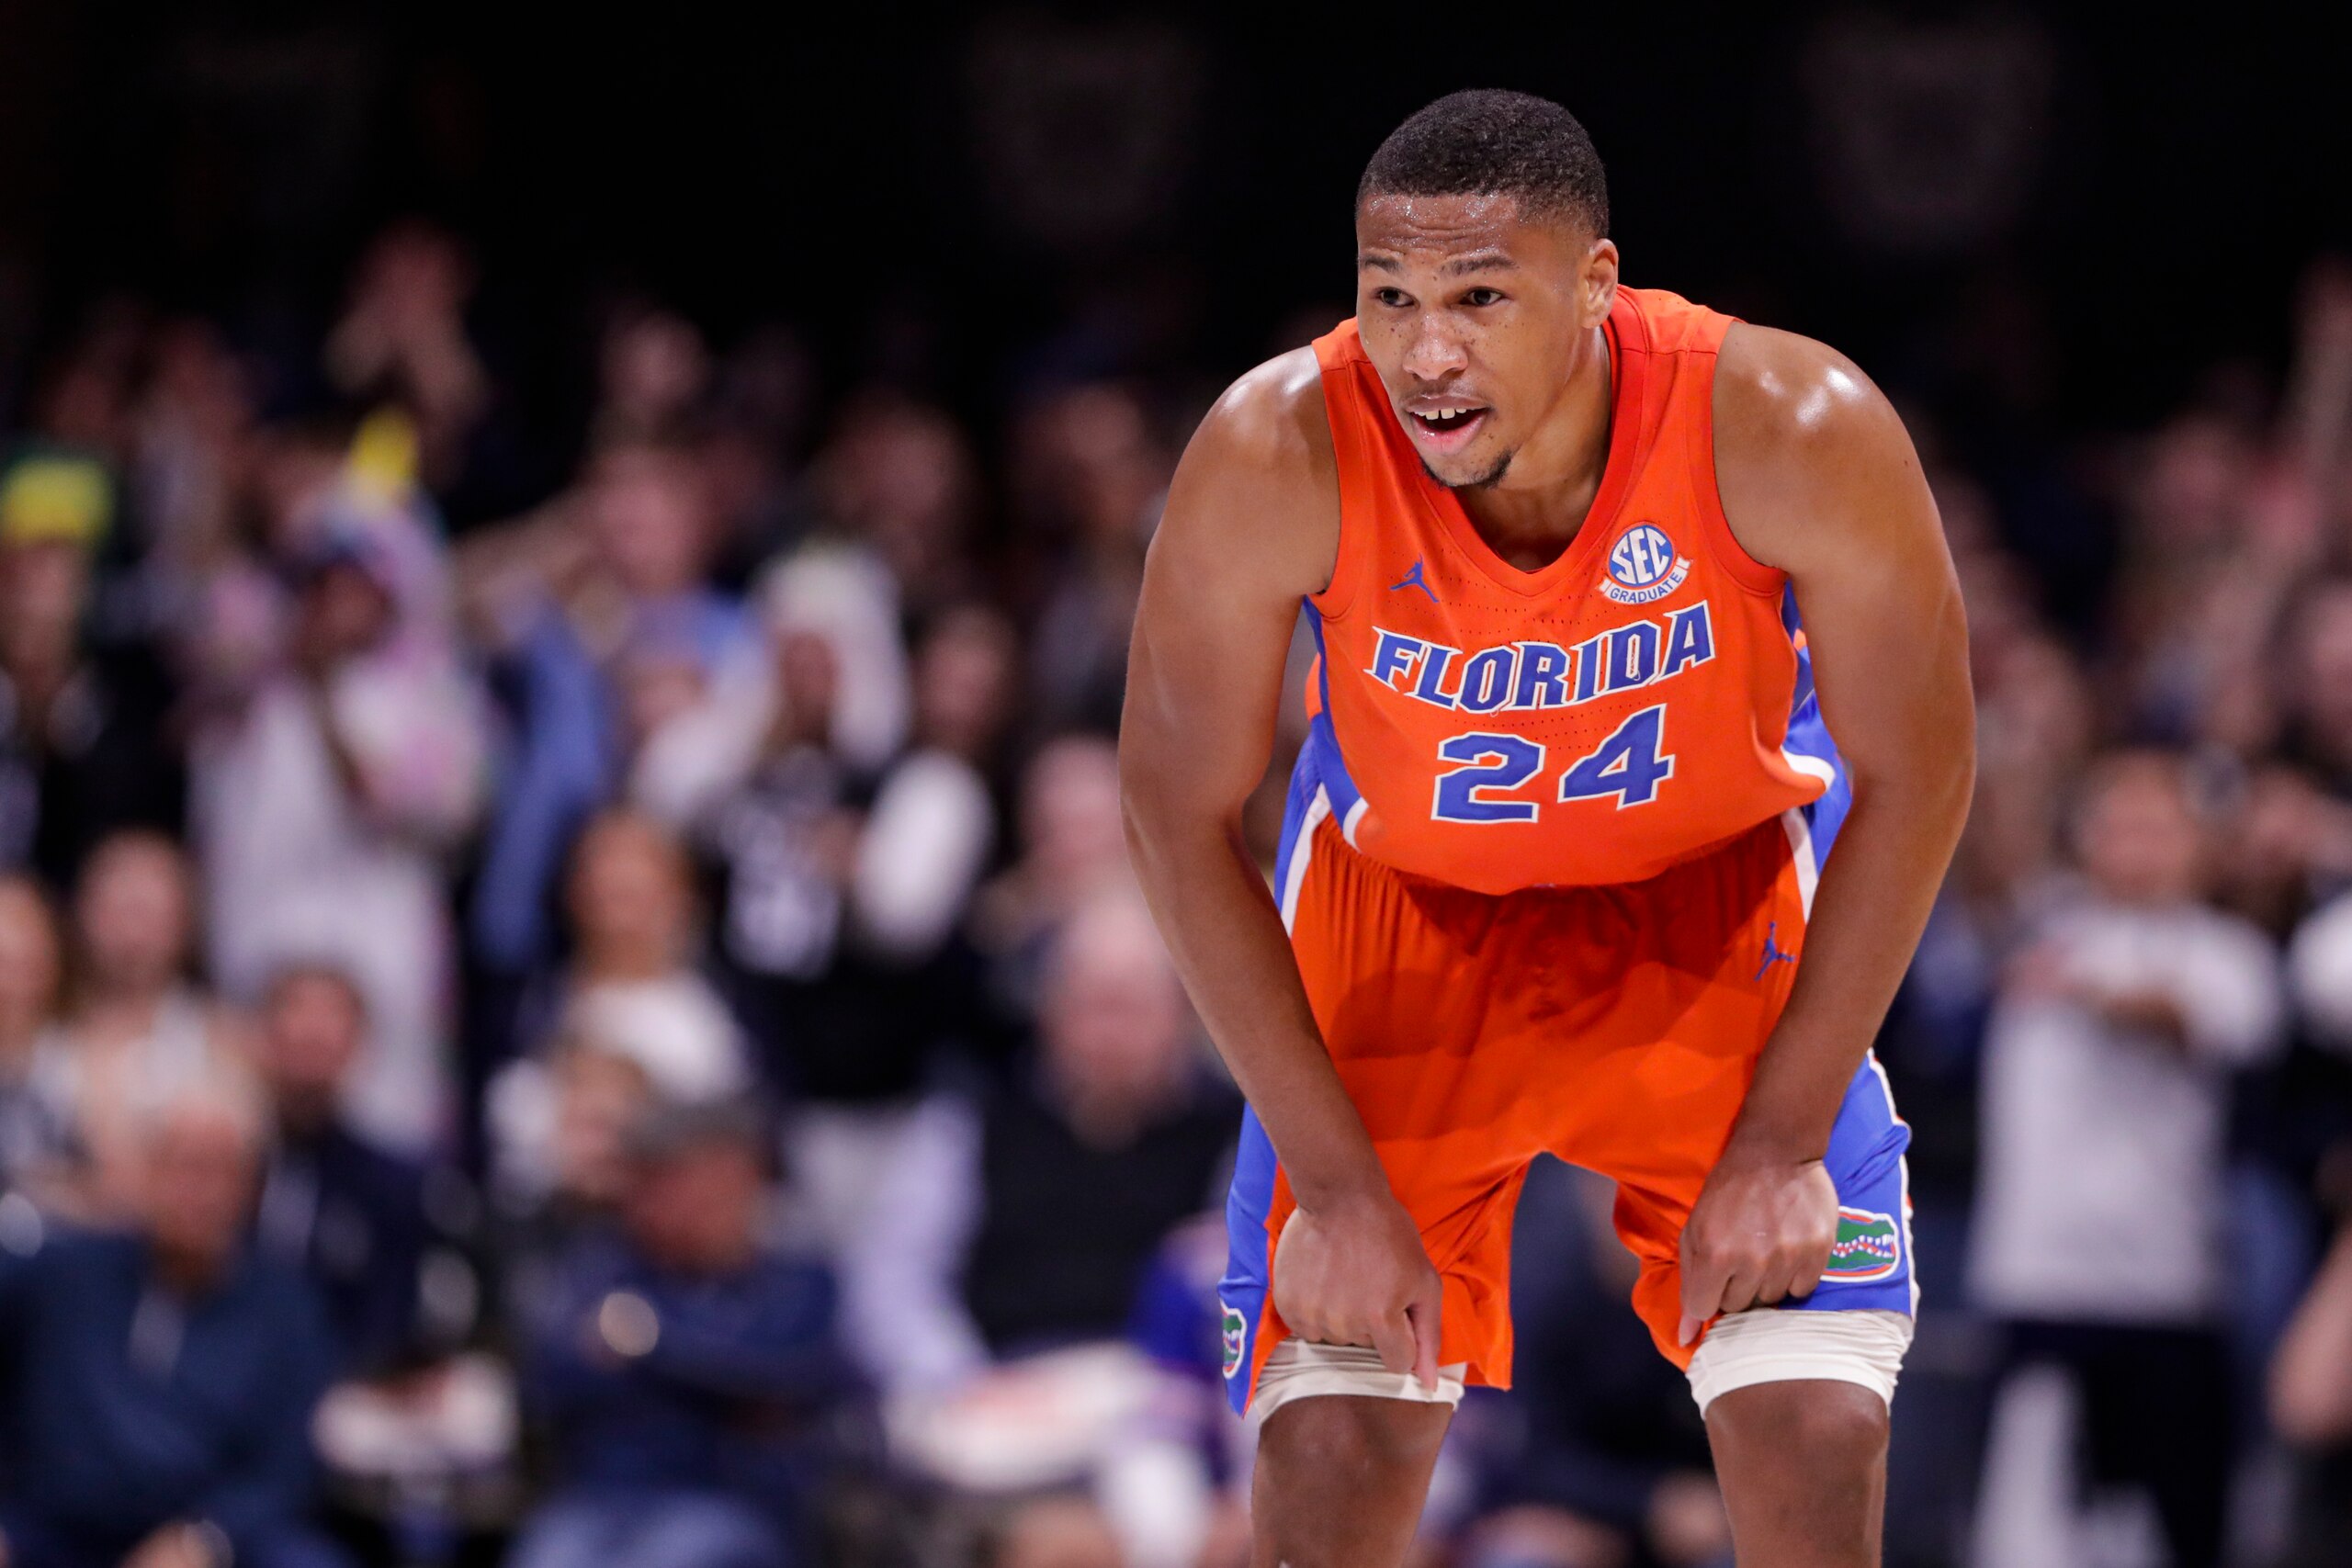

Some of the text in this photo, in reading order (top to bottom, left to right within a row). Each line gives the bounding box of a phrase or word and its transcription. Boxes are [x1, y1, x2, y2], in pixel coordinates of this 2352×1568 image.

[1610, 572, 1682, 604] GRADUATE
[1611, 526, 1669, 584] SEC
[1363, 600, 1715, 714] FLORIDA
[1430, 703, 1676, 823] 24
